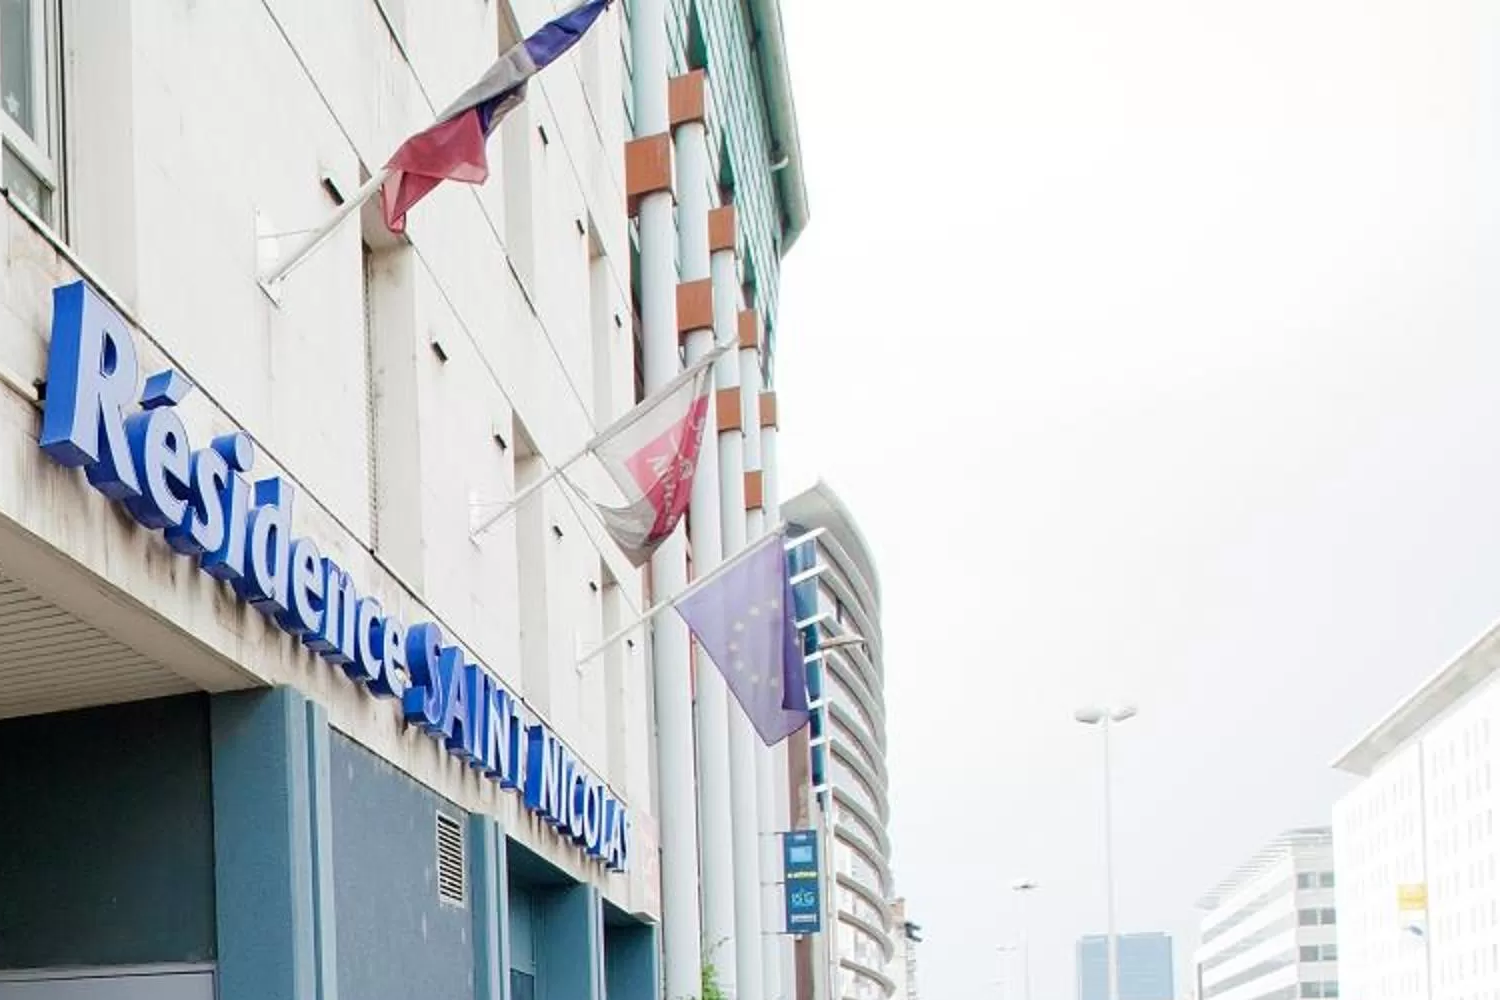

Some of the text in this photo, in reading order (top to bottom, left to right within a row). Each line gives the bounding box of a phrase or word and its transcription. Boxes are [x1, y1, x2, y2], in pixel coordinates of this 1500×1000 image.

[40, 278, 629, 874] Résidence SAINT NICOLAS
